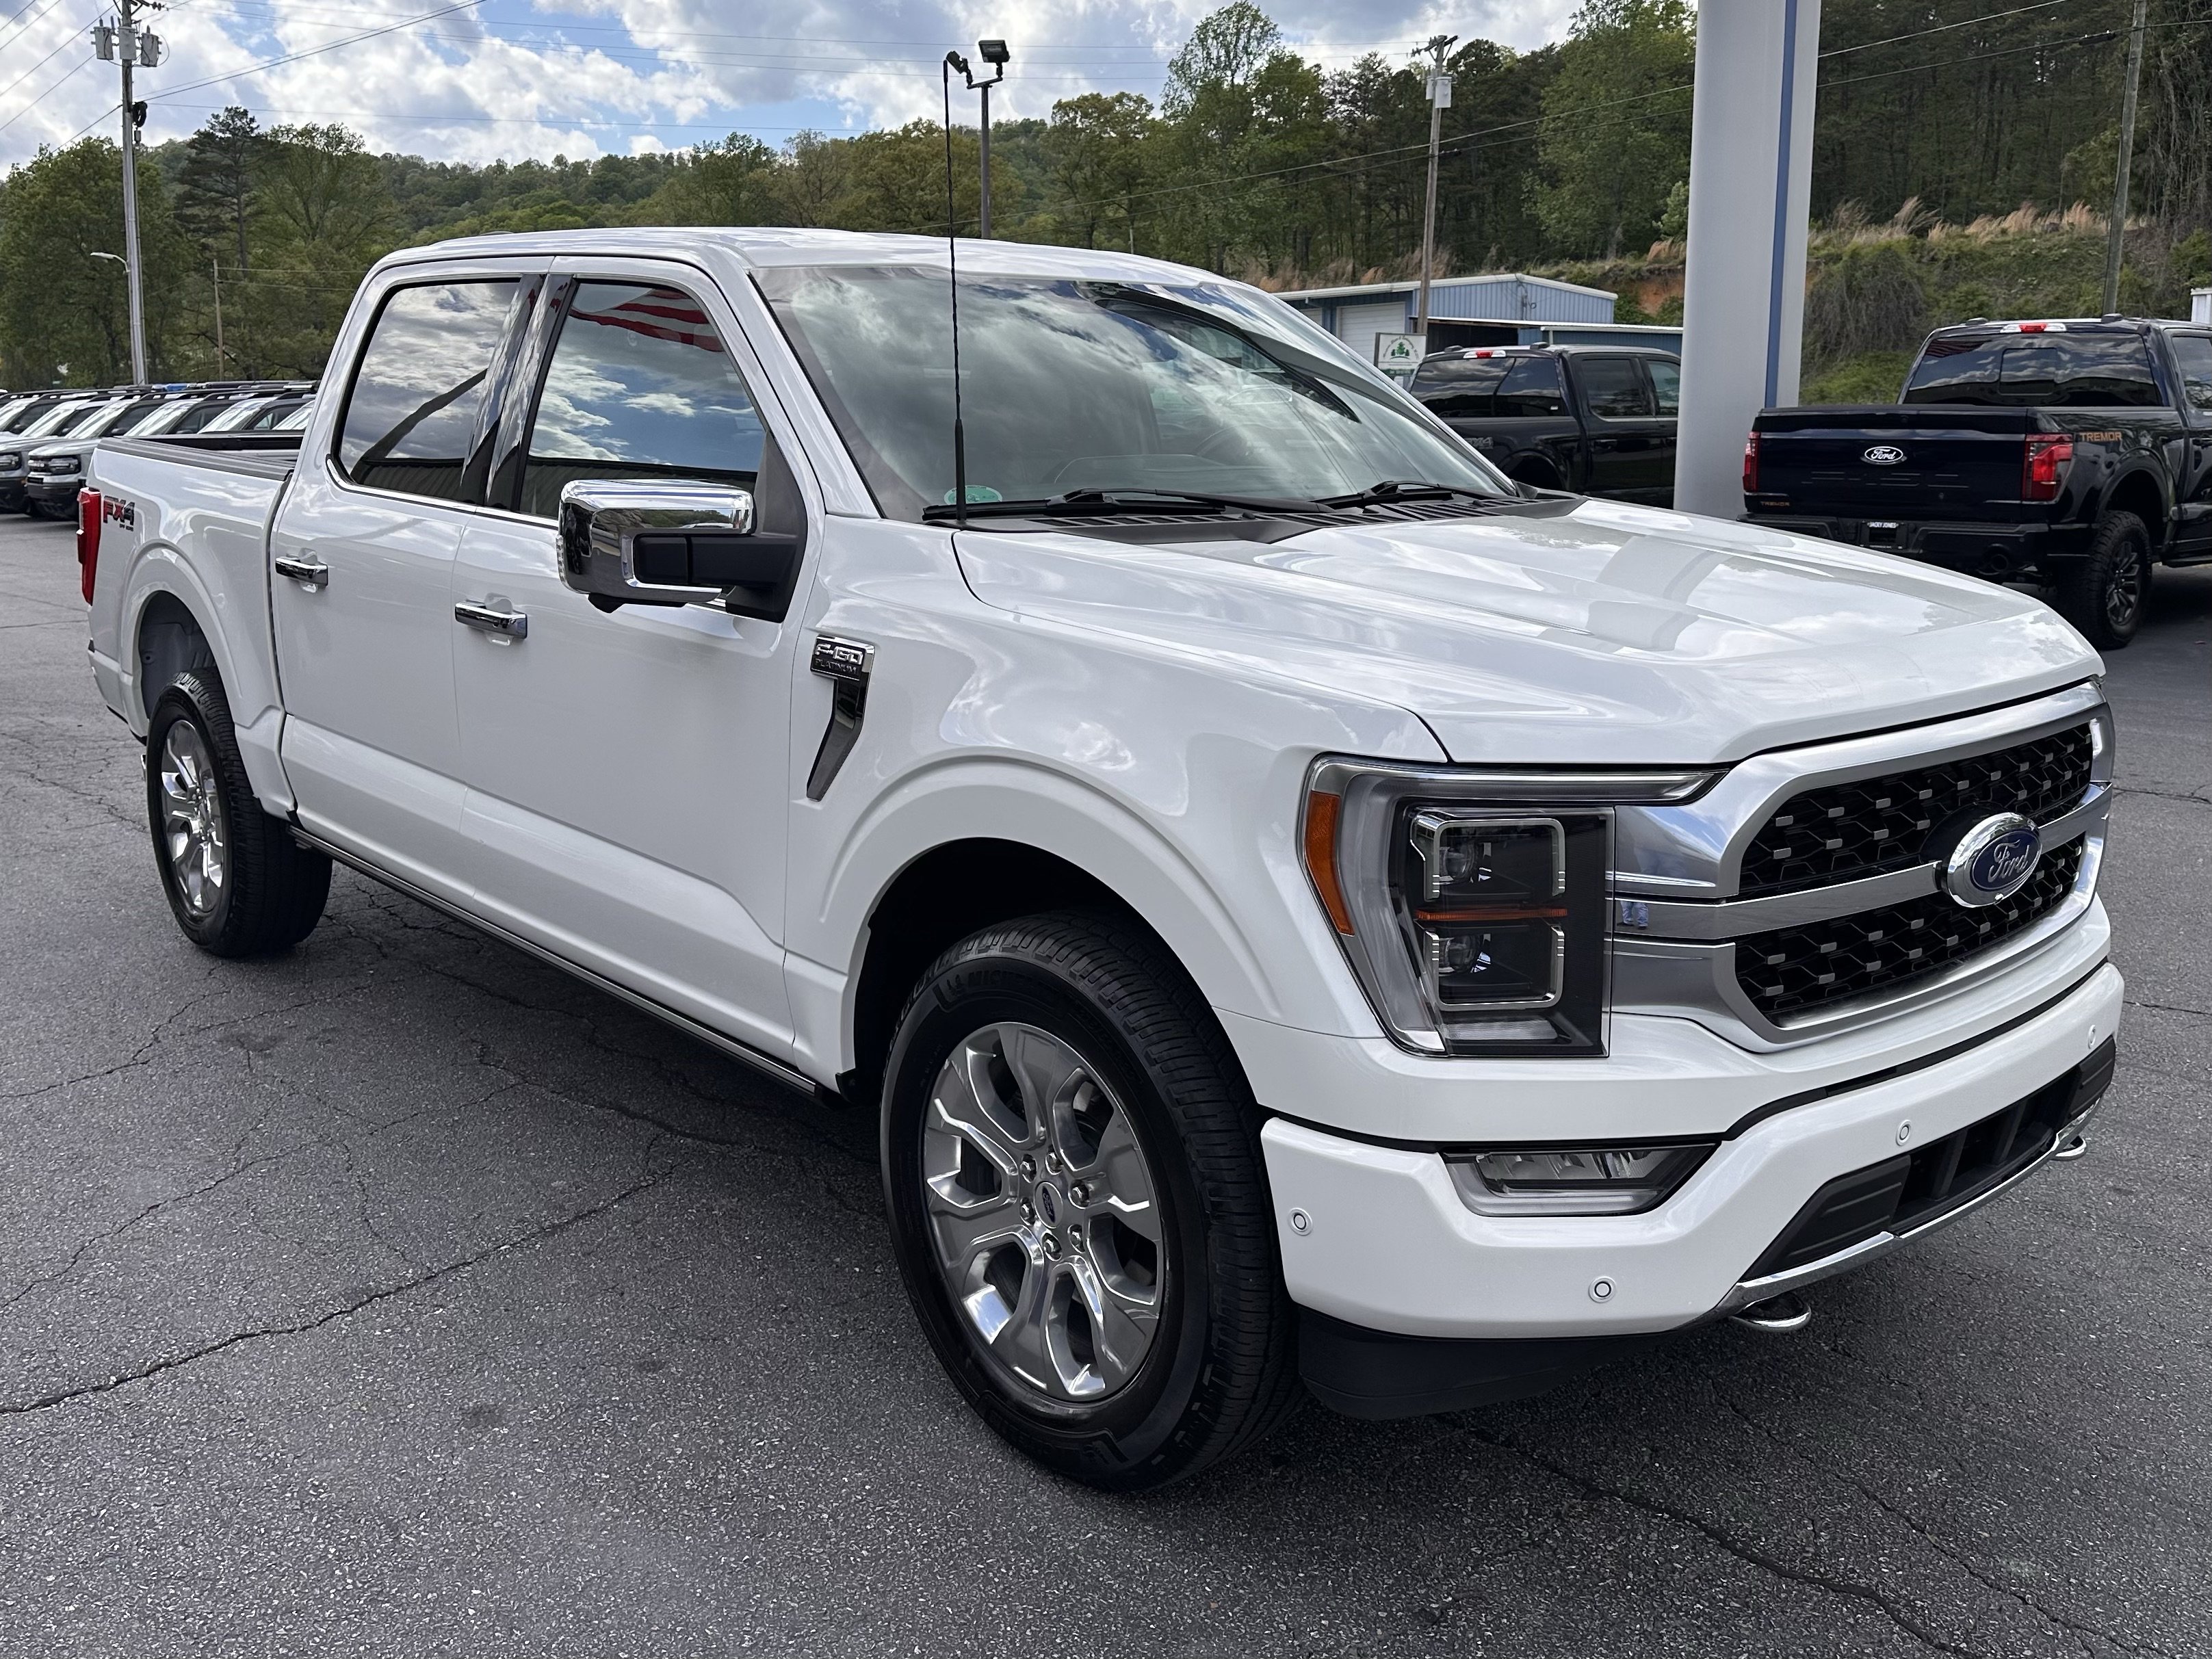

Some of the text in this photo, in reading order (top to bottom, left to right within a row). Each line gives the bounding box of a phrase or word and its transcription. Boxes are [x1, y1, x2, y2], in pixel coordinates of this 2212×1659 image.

[2079, 432, 2122, 441] TREMOR
[1871, 448, 1897, 460] Ford
[103, 495, 135, 525] FX4
[815, 643, 863, 665] F-150
[1987, 839, 2030, 883] Ford
